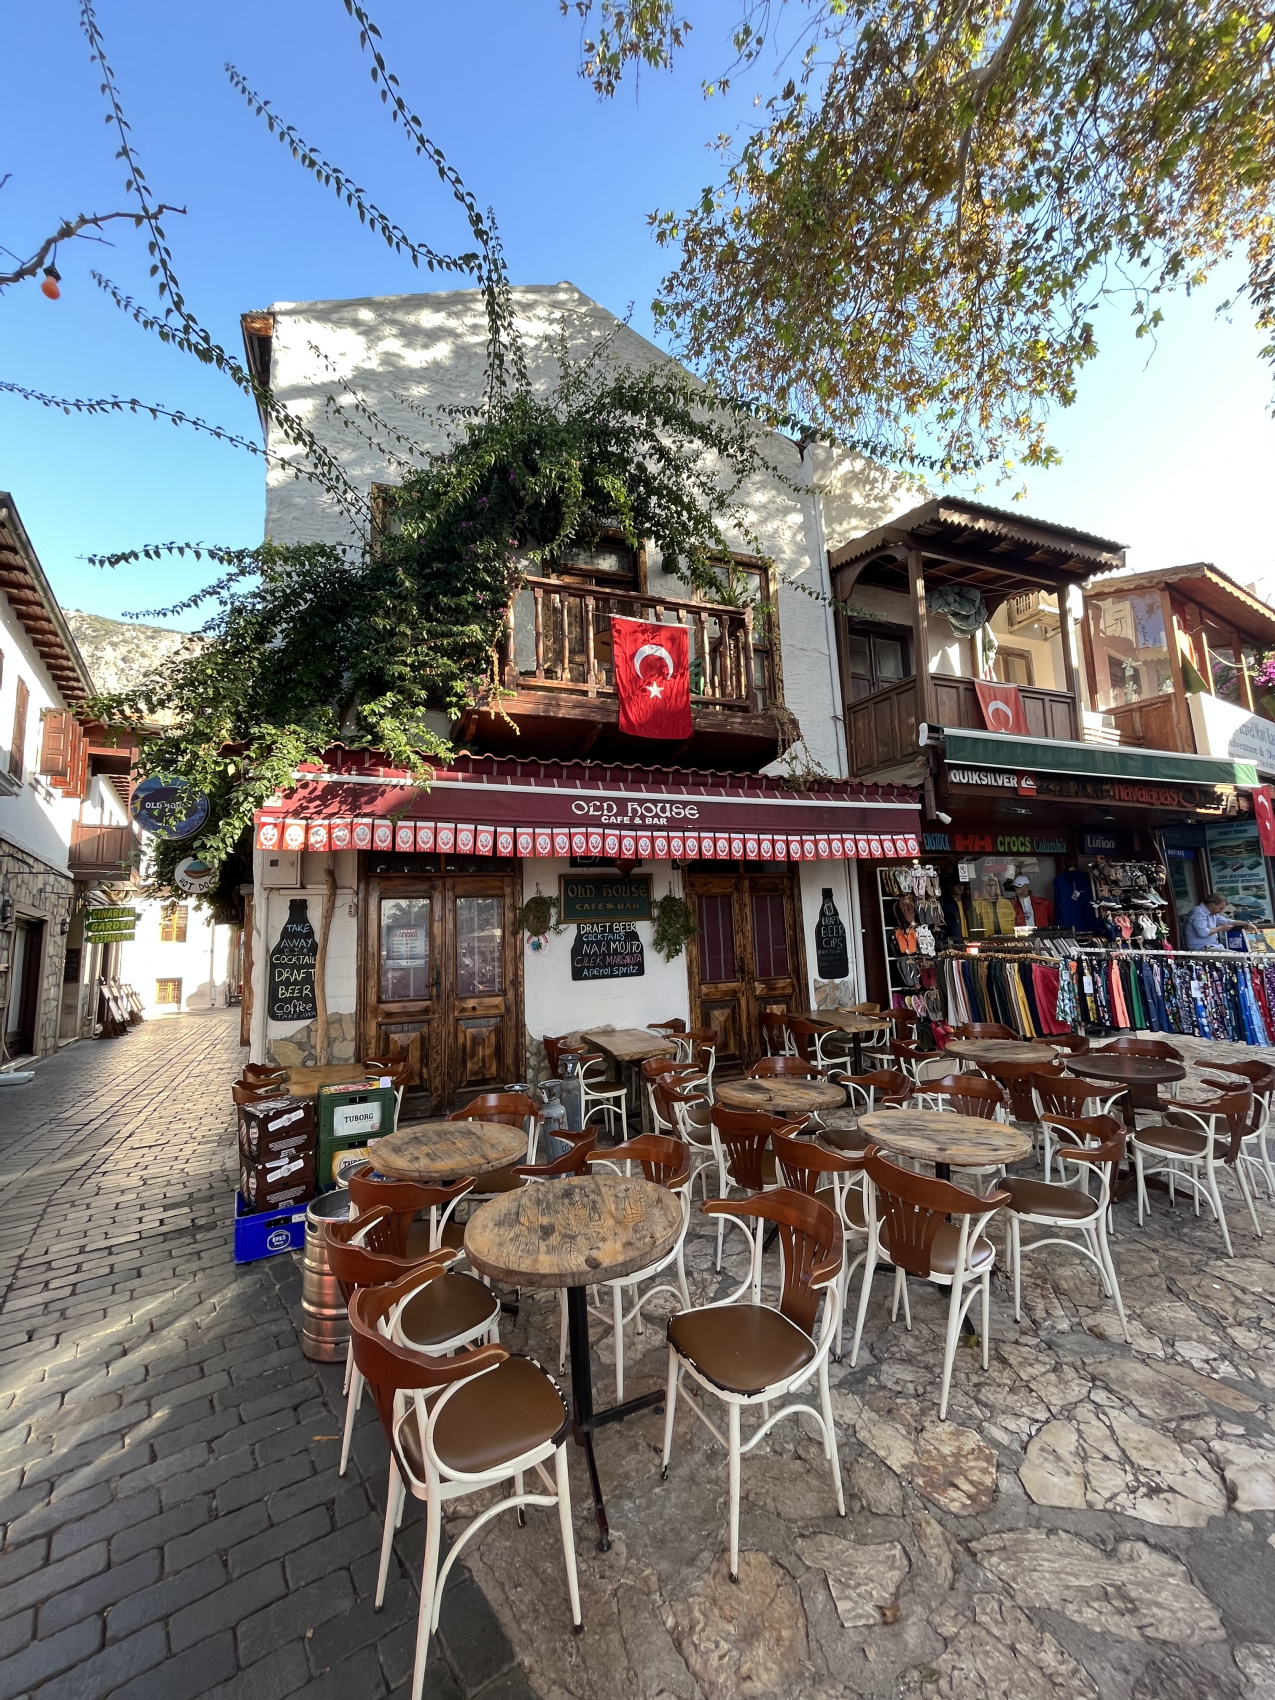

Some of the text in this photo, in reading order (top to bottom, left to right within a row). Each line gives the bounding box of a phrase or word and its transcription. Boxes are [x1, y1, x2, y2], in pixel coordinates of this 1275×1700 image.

[949, 769, 1018, 788] QUIKSILVER
[145, 801, 163, 809] OLD
[571, 800, 618, 816] OLD
[601, 815, 668, 825] CAFE & BAR
[955, 834, 992, 852] HH
[997, 835, 1031, 853] crocs
[1033, 837, 1067, 853] Columbia
[1086, 836, 1115, 849] Lufian
[179, 877, 195, 891] HOT
[567, 884, 595, 898] OLD
[576, 902, 604, 911] CAFE
[91, 920, 134, 931] GARDEN
[285, 923, 310, 934] TAKE
[580, 921, 637, 935] DRAFT BEER
[821, 925, 846, 938] BEER
[582, 932, 626, 941] COCKTAILS
[280, 938, 313, 949] AWAY
[582, 941, 608, 955] NAR
[275, 968, 316, 983] DRAFT
[582, 966, 611, 978] Aperol
[278, 984, 312, 999] BEER
[274, 999, 313, 1014] Coffee
[275, 1012, 299, 1020] TAKE
[344, 1112, 374, 1124] TUBORG
